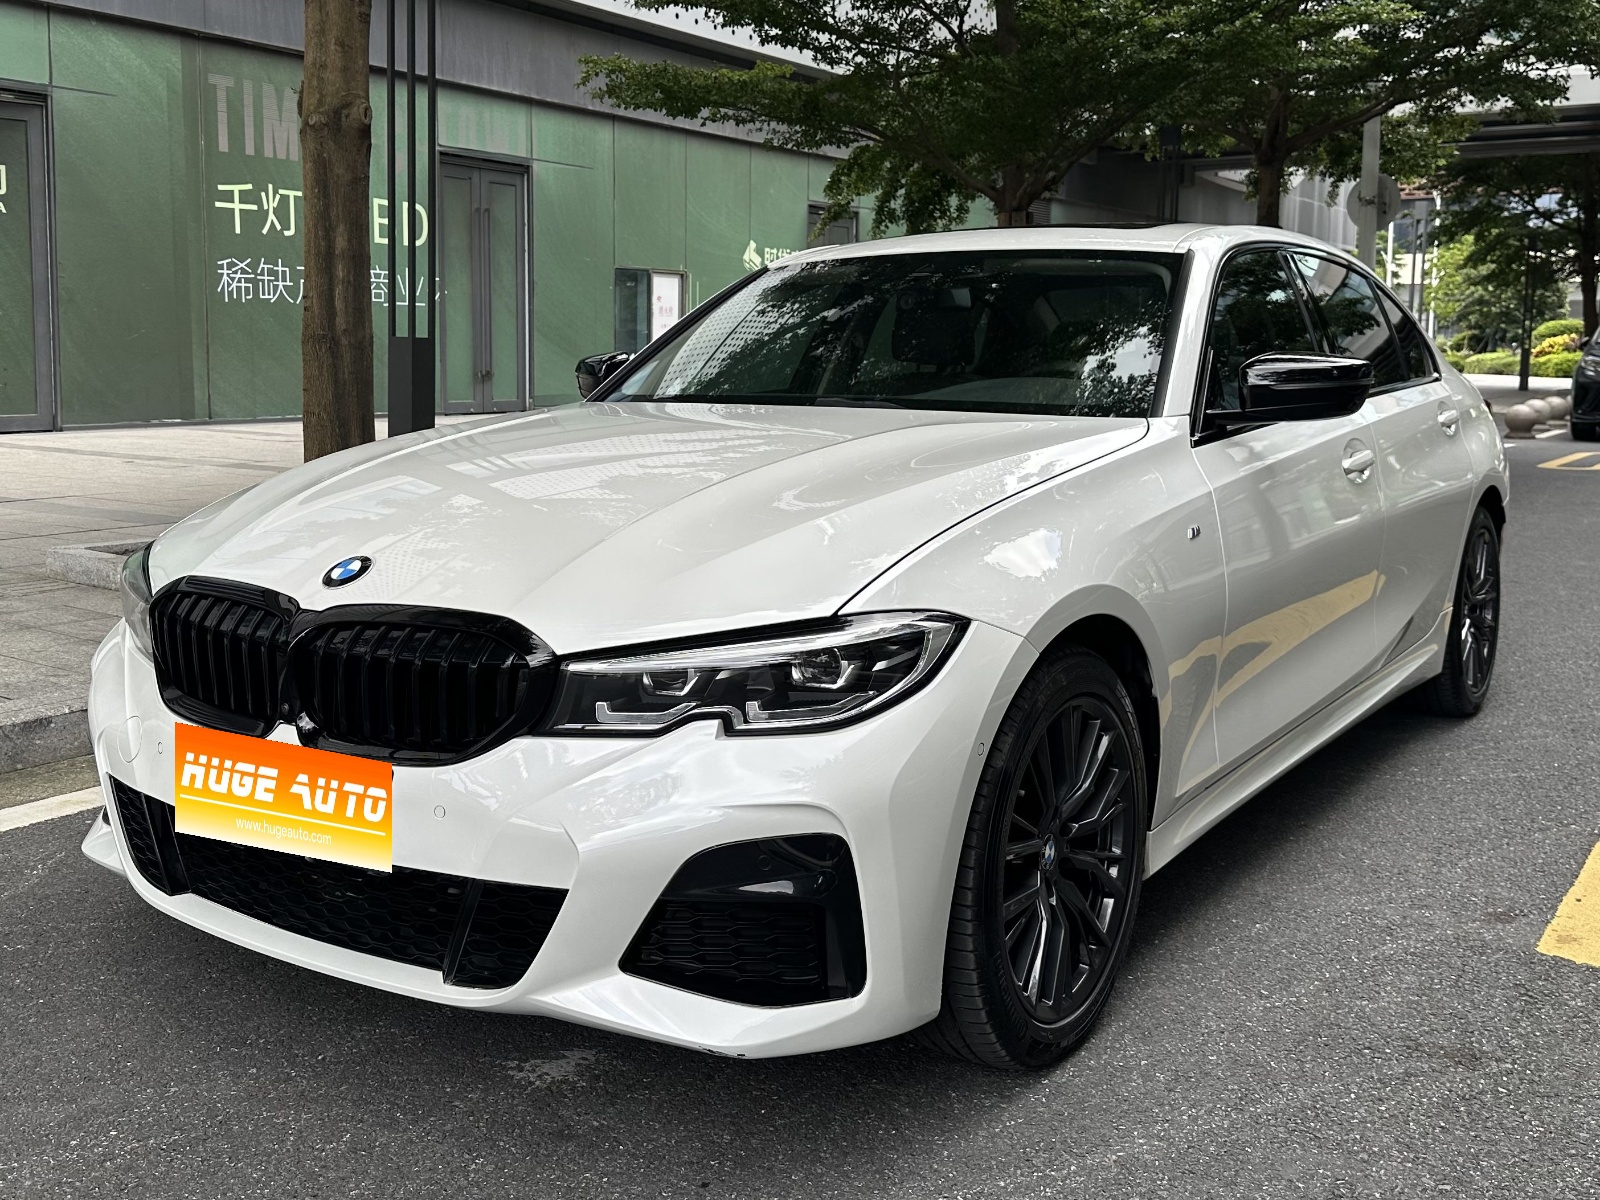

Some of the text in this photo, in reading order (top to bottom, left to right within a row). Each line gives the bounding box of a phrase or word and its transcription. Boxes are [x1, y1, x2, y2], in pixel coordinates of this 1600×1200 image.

[214, 183, 303, 236] 千灯
[217, 257, 448, 306] 稀缺 商业
